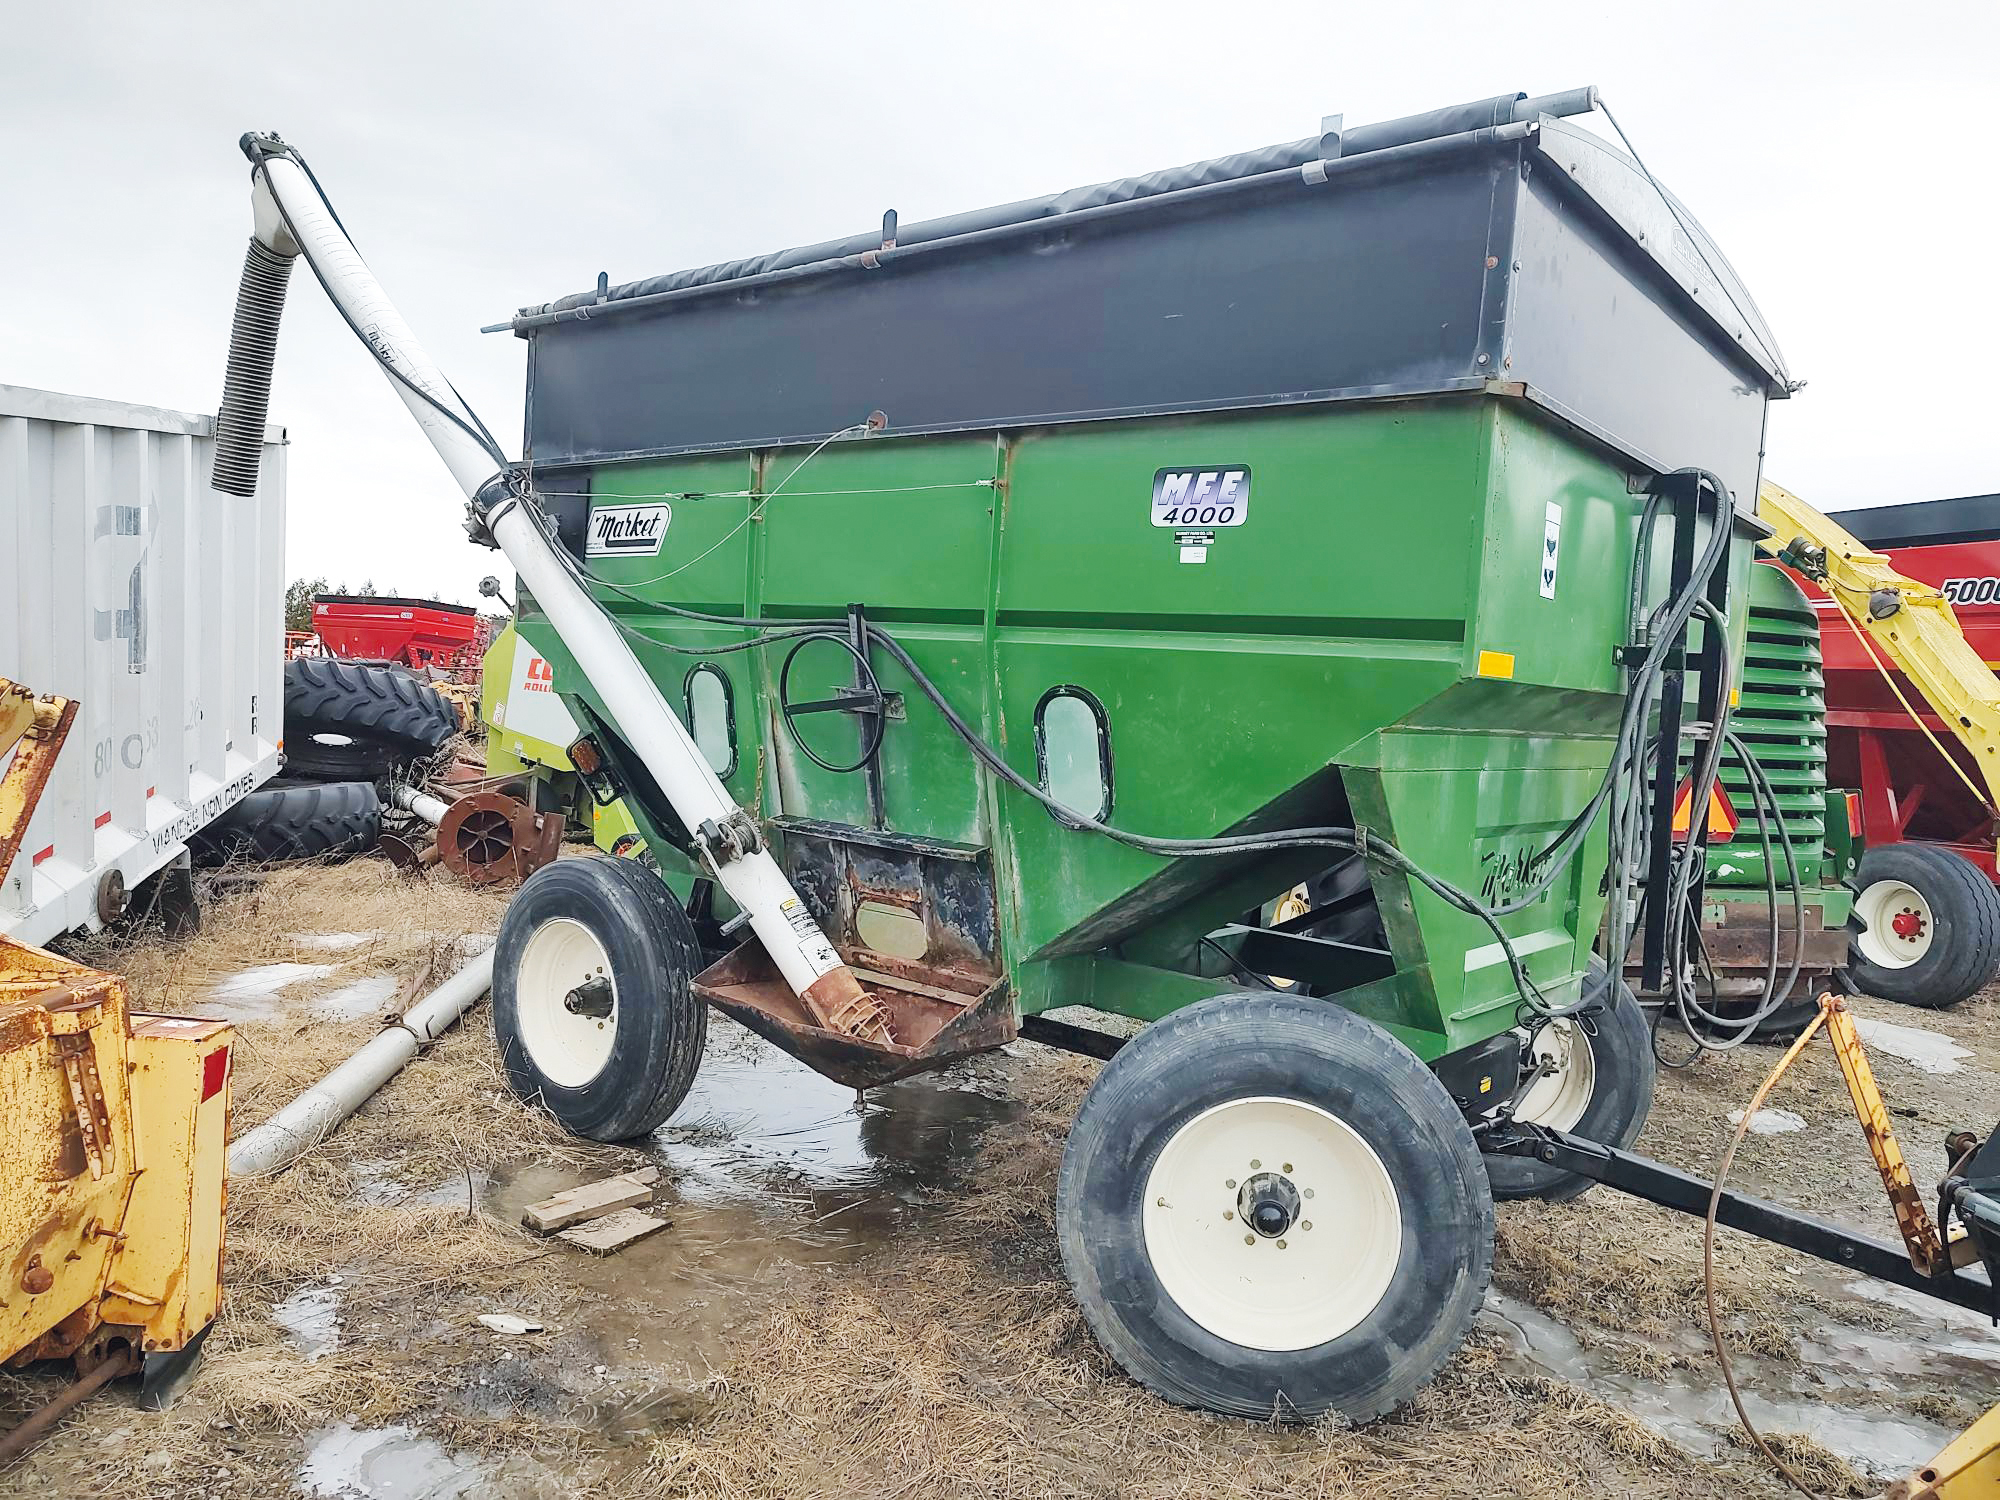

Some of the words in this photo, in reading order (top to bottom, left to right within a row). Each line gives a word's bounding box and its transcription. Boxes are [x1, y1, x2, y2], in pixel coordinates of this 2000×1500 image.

[1157, 470, 1245, 506] MFE
[595, 511, 662, 543] Market
[1162, 506, 1235, 524] 4000
[523, 682, 554, 693] ROLL
[202, 792, 223, 825] NON
